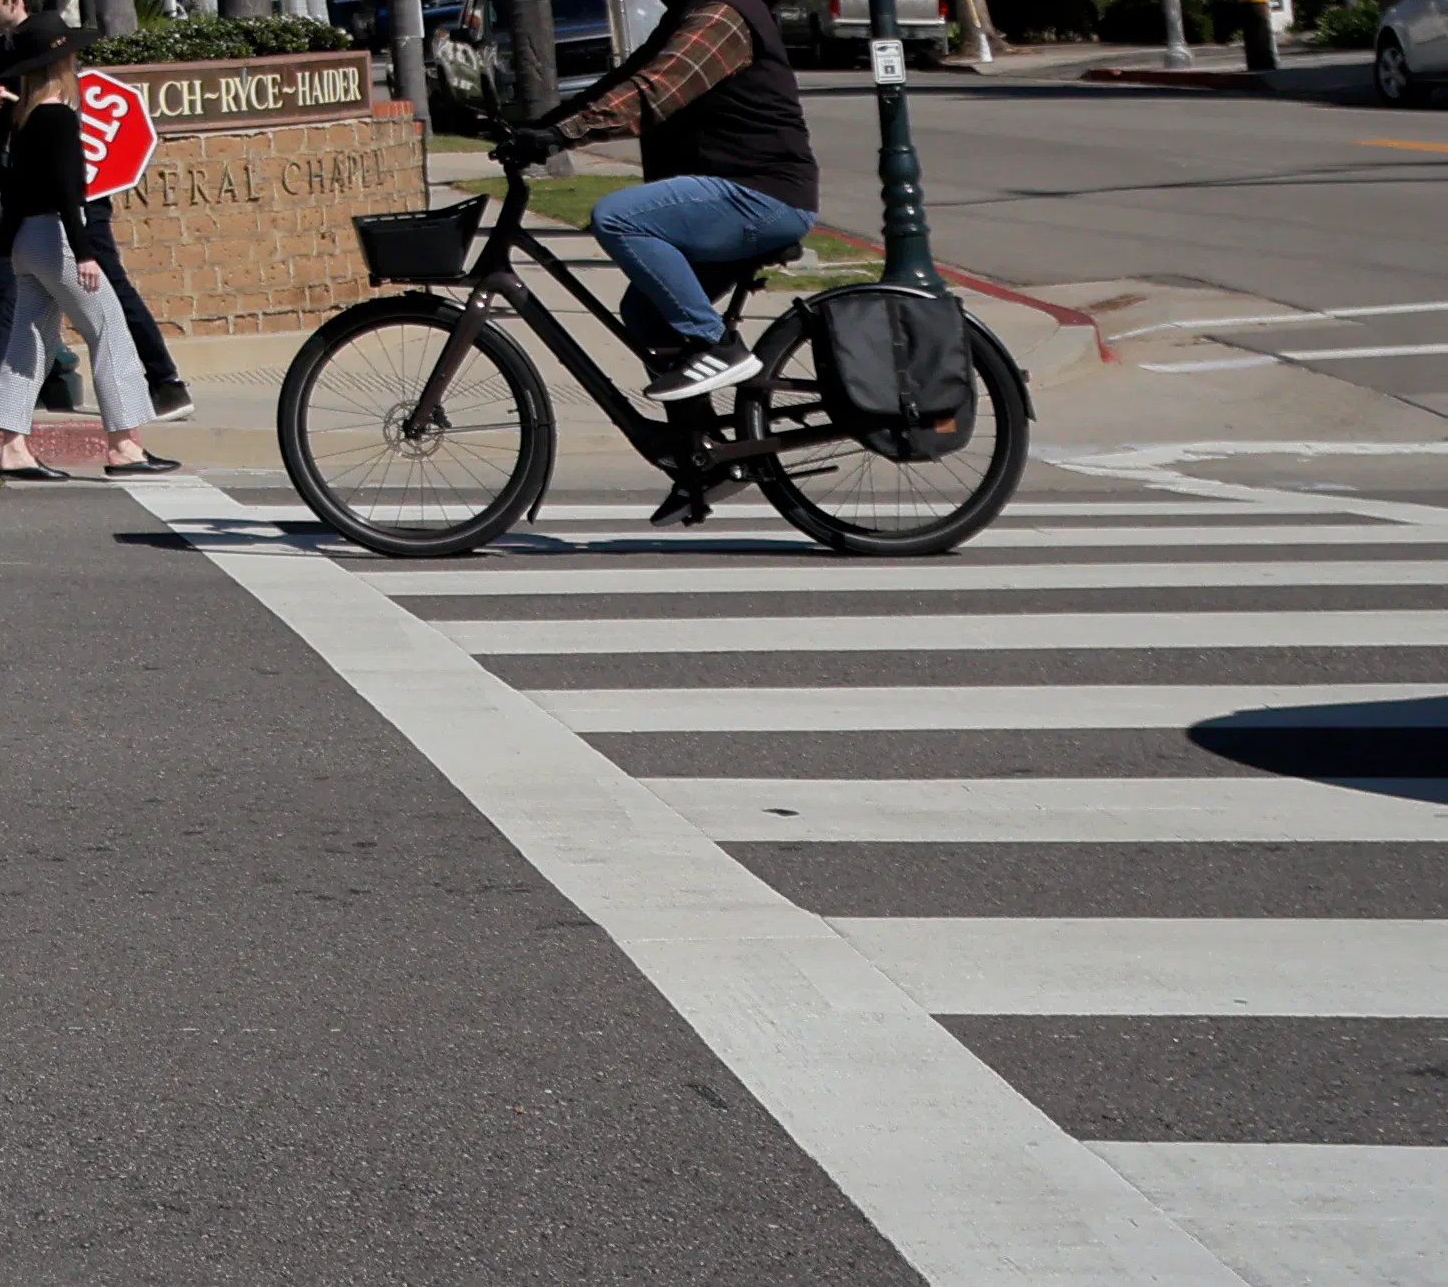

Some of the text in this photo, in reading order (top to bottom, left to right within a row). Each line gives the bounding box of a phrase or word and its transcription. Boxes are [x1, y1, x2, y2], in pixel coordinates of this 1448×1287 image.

[80, 85, 129, 185] STO
[124, 148, 390, 209] NERAL CHAPEL
